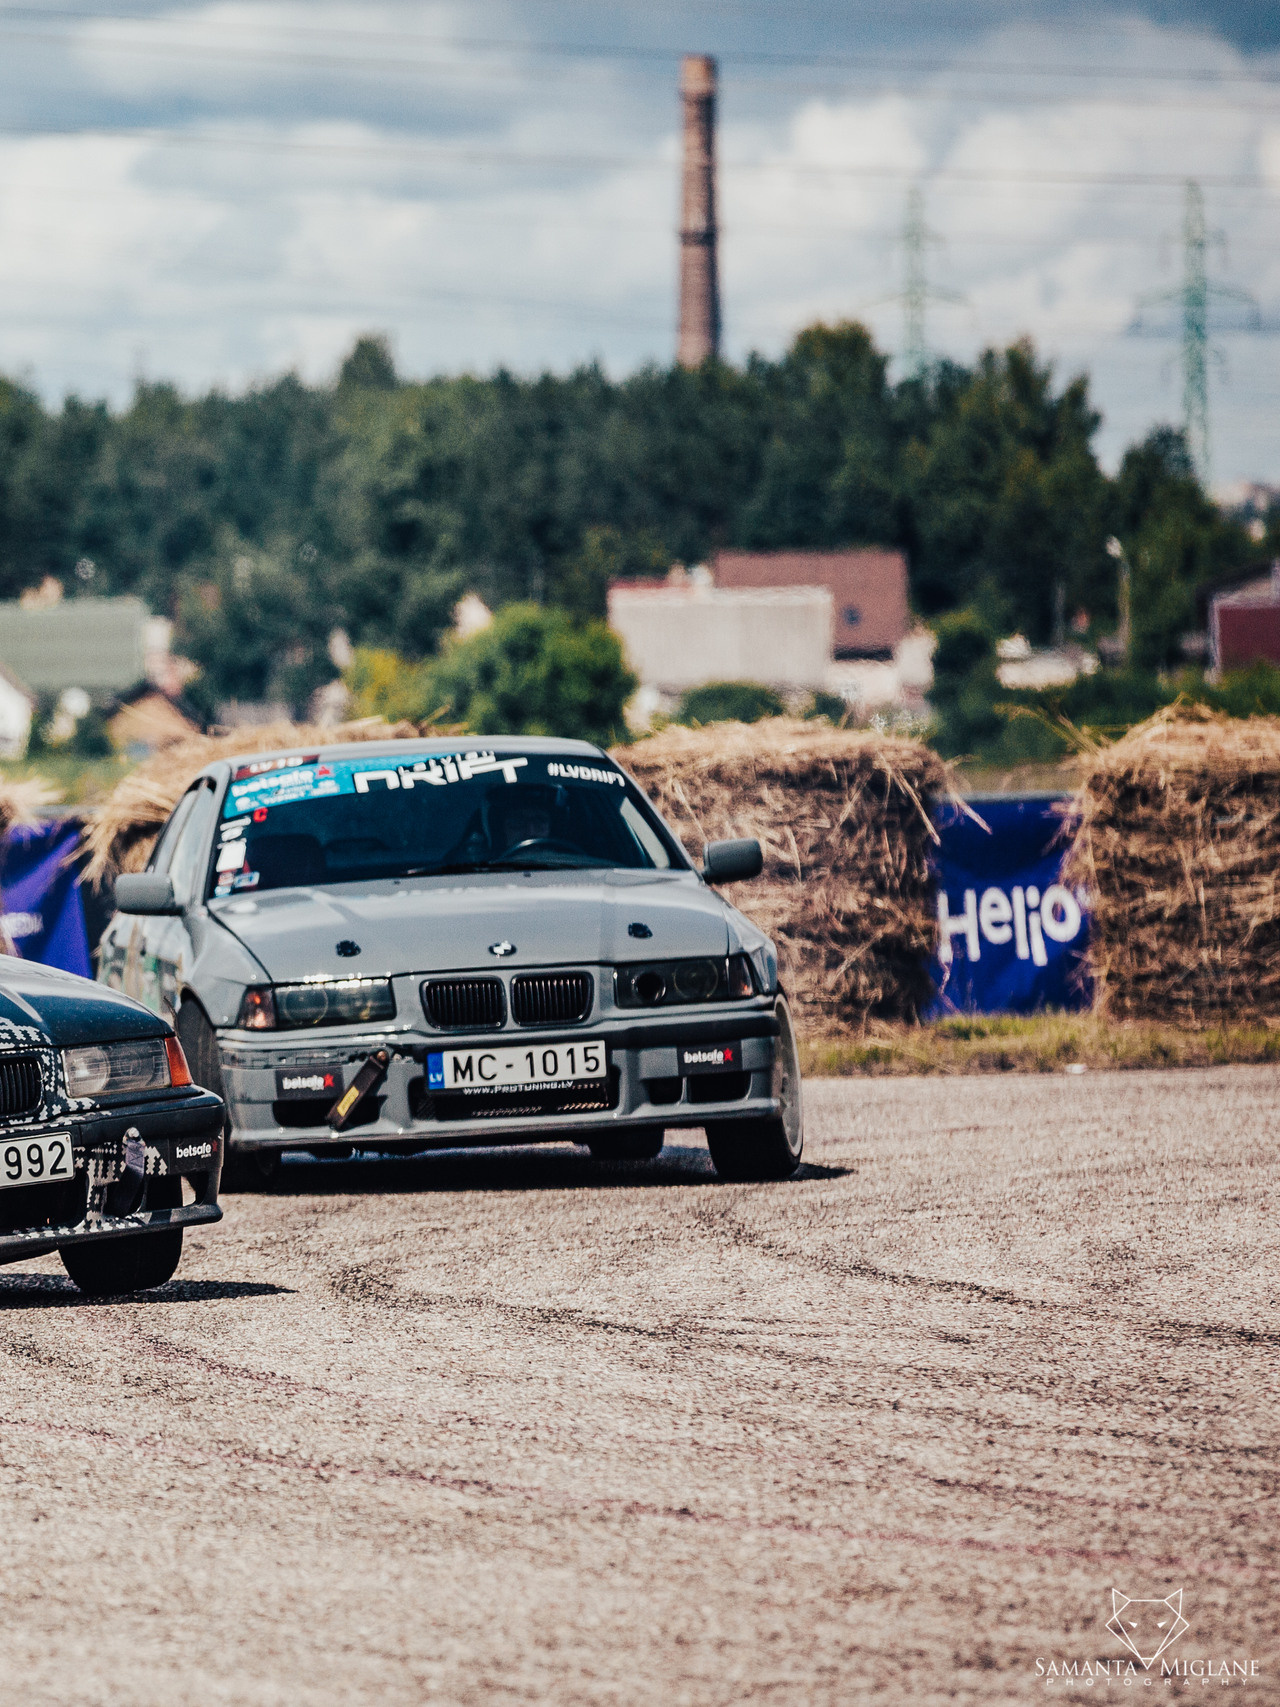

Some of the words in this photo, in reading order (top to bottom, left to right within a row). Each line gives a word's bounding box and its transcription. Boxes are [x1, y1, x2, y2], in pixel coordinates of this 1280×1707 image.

[353, 757, 528, 794] DRIFT
[429, 1072, 443, 1083] LV
[452, 1046, 600, 1084] MC-1015
[176, 1142, 212, 1159] betsafe
